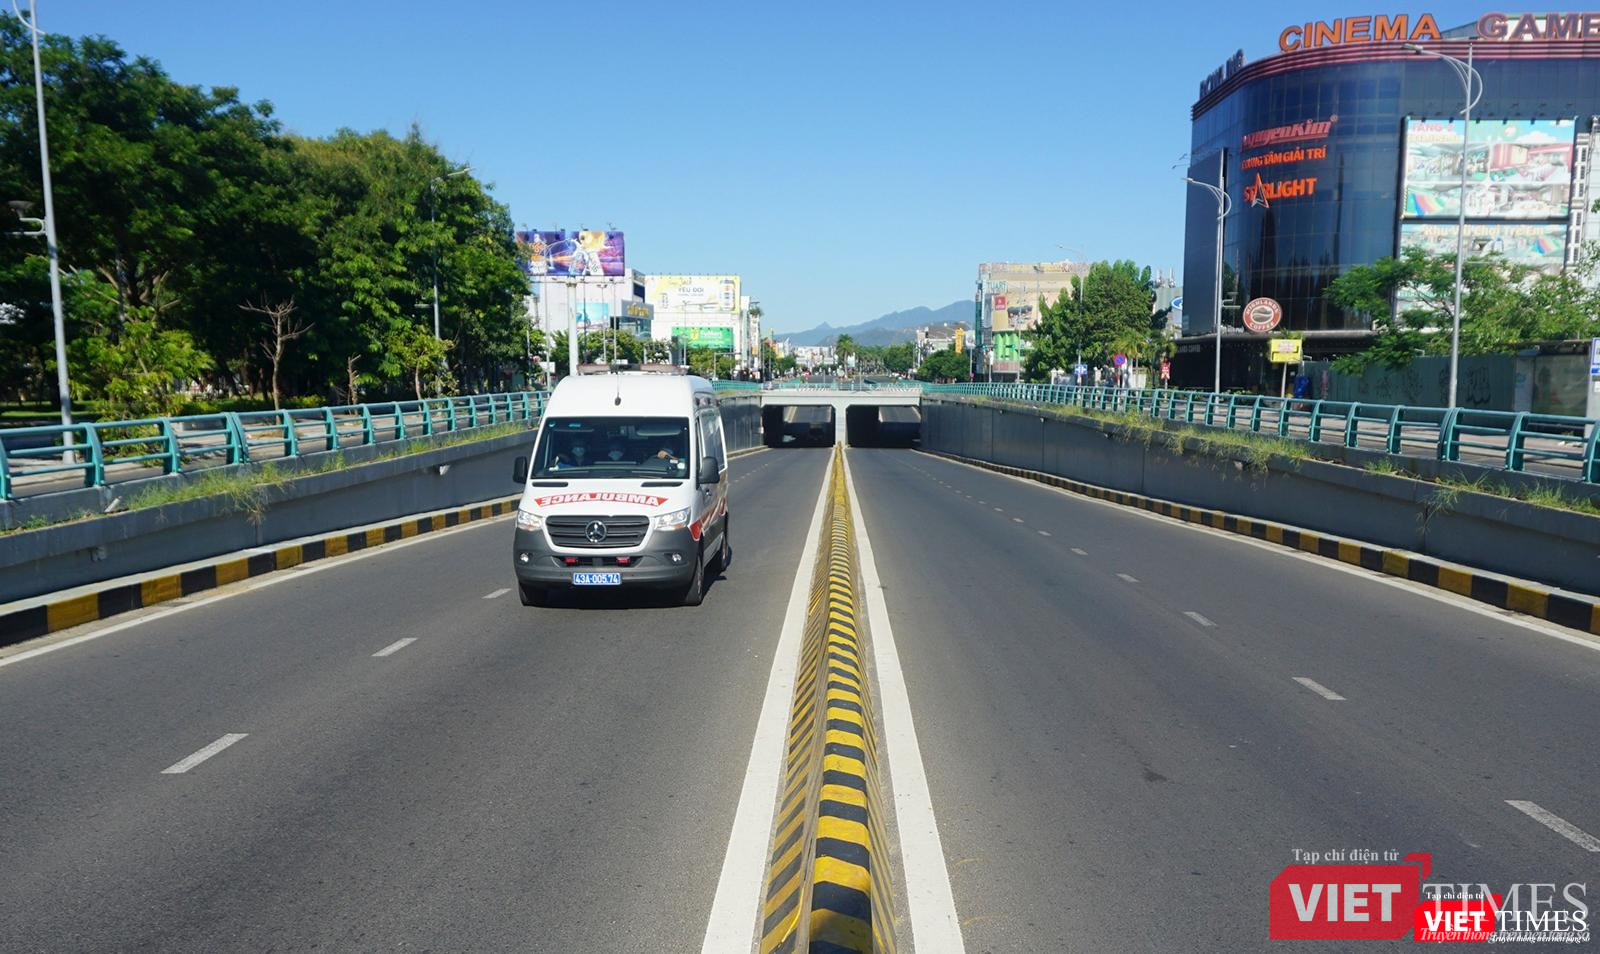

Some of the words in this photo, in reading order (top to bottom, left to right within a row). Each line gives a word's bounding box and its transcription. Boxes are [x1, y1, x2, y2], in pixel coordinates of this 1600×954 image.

[1279, 13, 1442, 52] CINEMA
[1476, 11, 1600, 41] GAME
[1306, 144, 1327, 160] TRÍ
[1244, 173, 1317, 207] STARLIGHT
[1249, 321, 1275, 331] COFFEE
